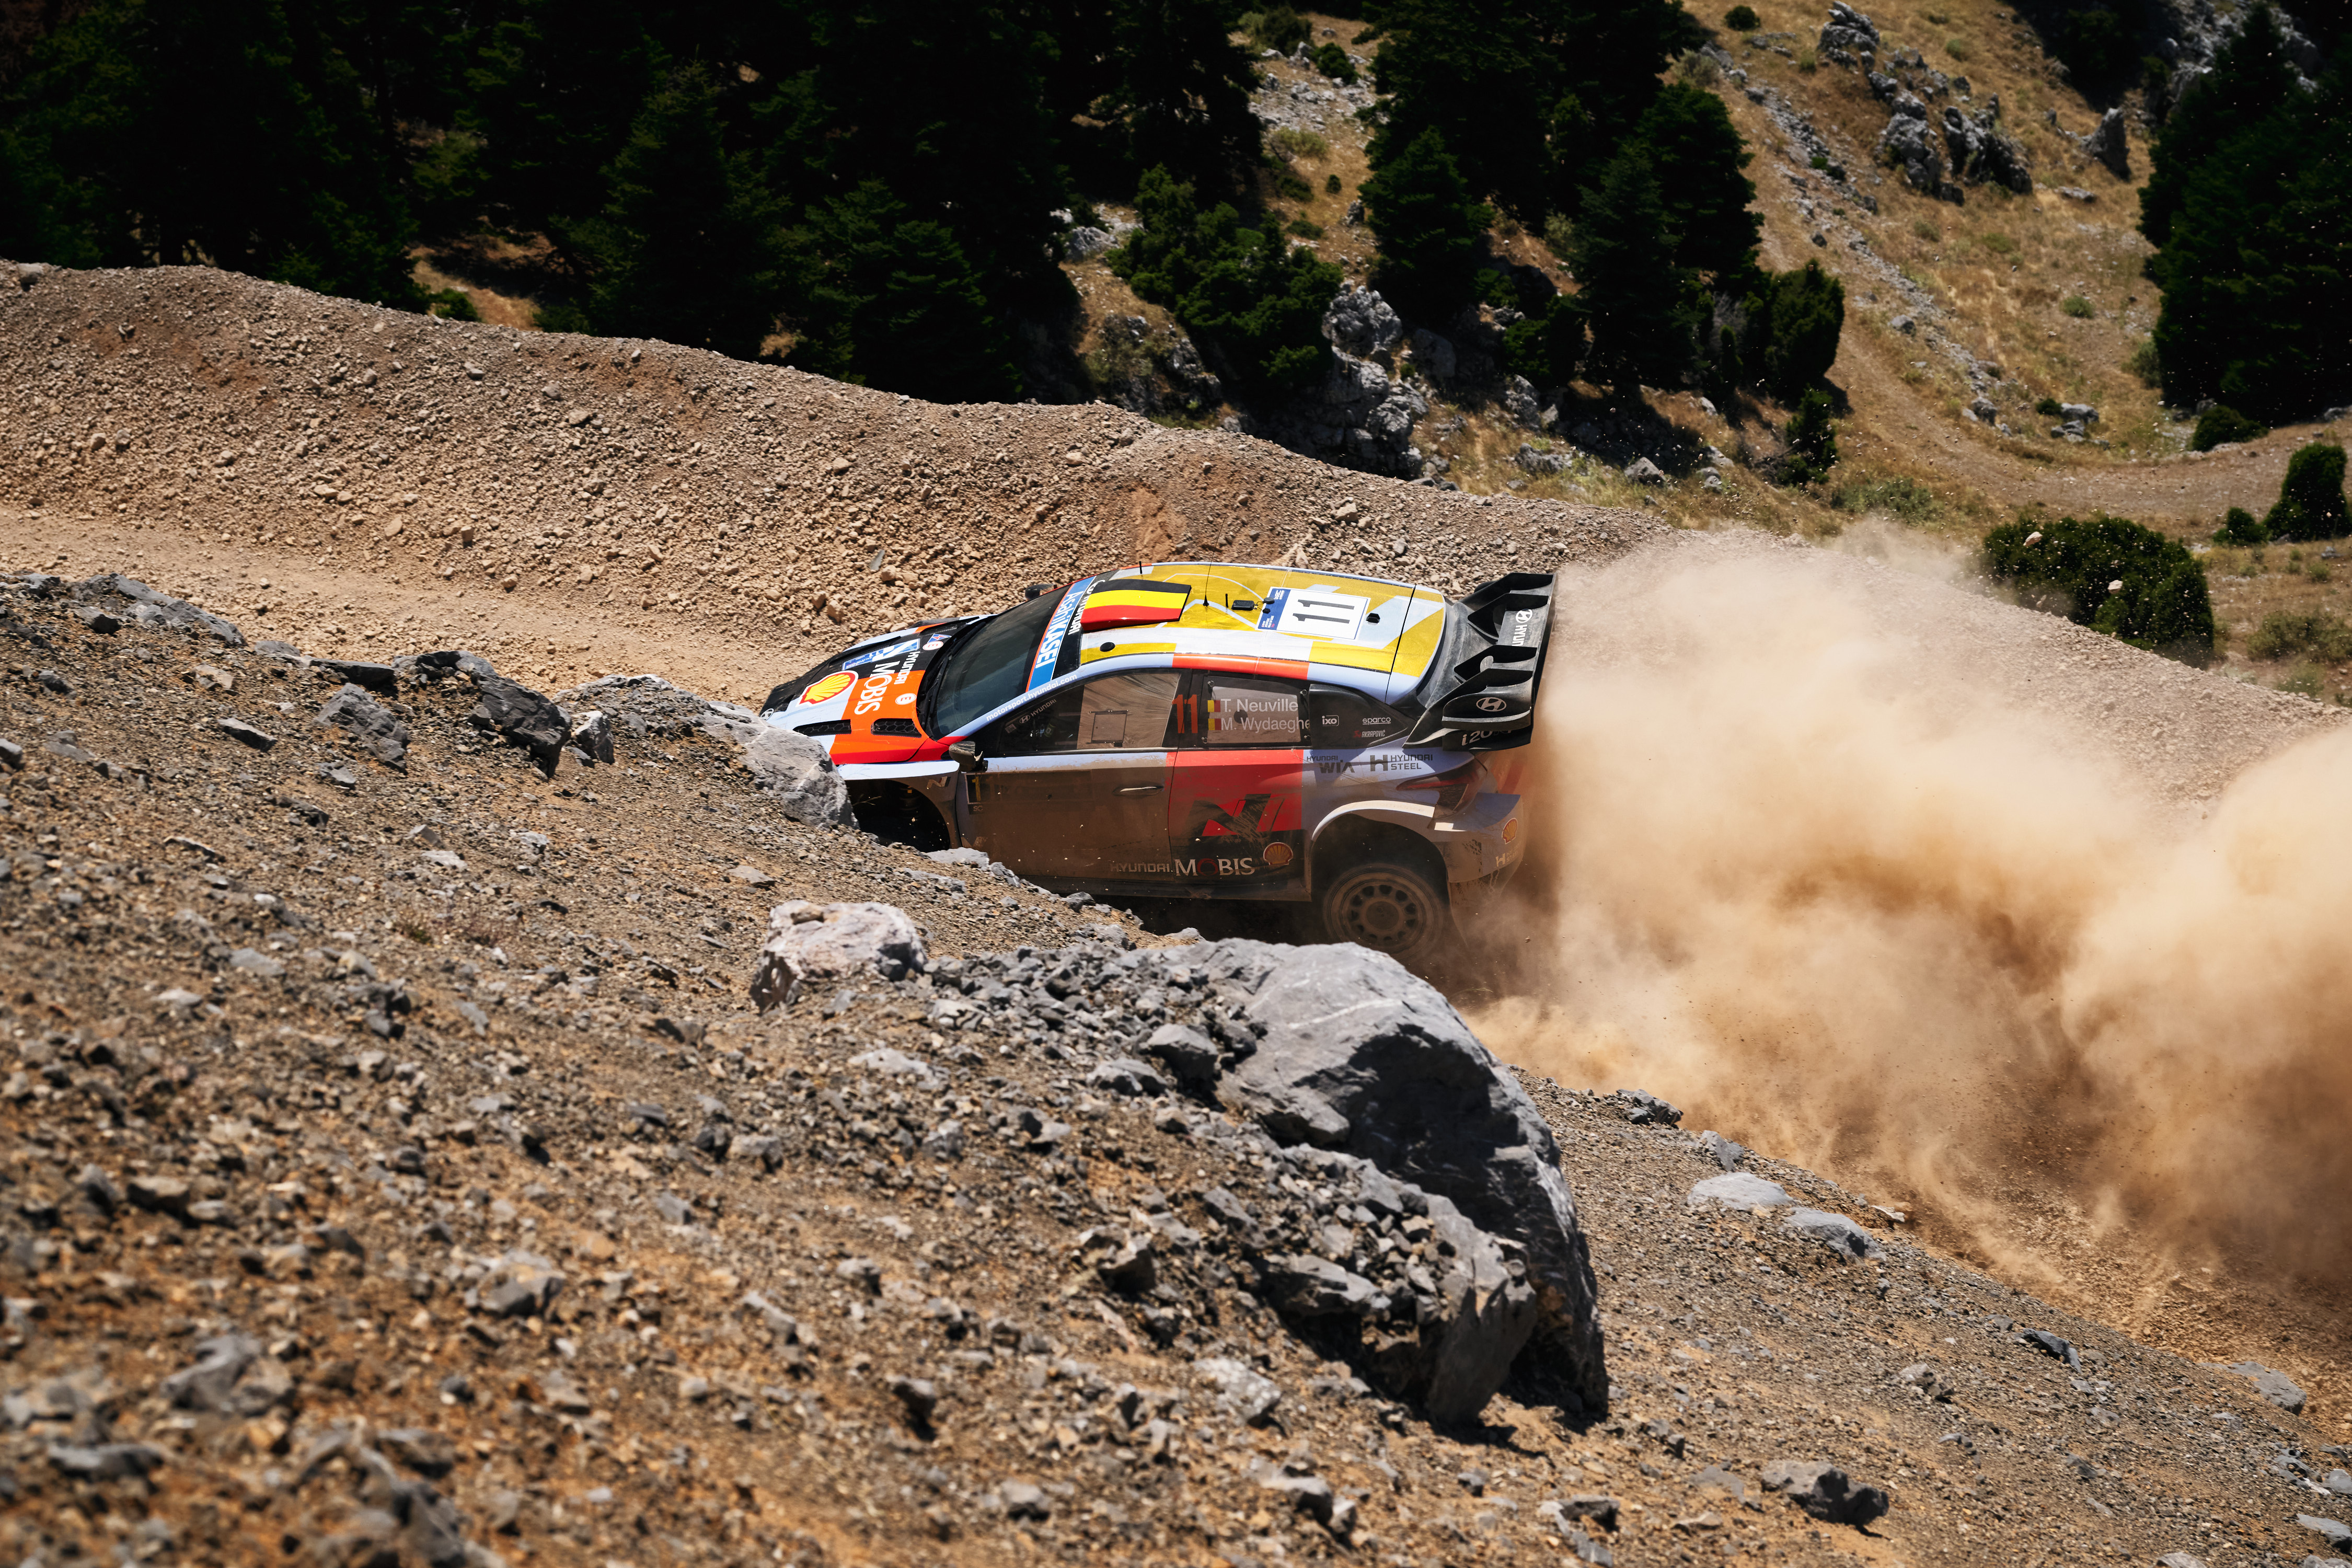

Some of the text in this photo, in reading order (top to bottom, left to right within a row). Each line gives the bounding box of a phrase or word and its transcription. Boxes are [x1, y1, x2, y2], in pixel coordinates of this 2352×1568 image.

[1293, 599, 1355, 624] 11
[1512, 624, 1527, 646] HYUN
[854, 651, 920, 714] HYUNDAI MOBIS
[986, 674, 1077, 721] motorsport.hyundai.com
[1220, 698, 1298, 712] T. Neuville
[1031, 699, 1057, 717] HYUNDAI
[1171, 694, 1198, 734] 11
[1221, 717, 1310, 733] M. Wydaeghe
[1363, 717, 1391, 725] sparco
[1111, 858, 1255, 877] HYUNDAI MOBIS
